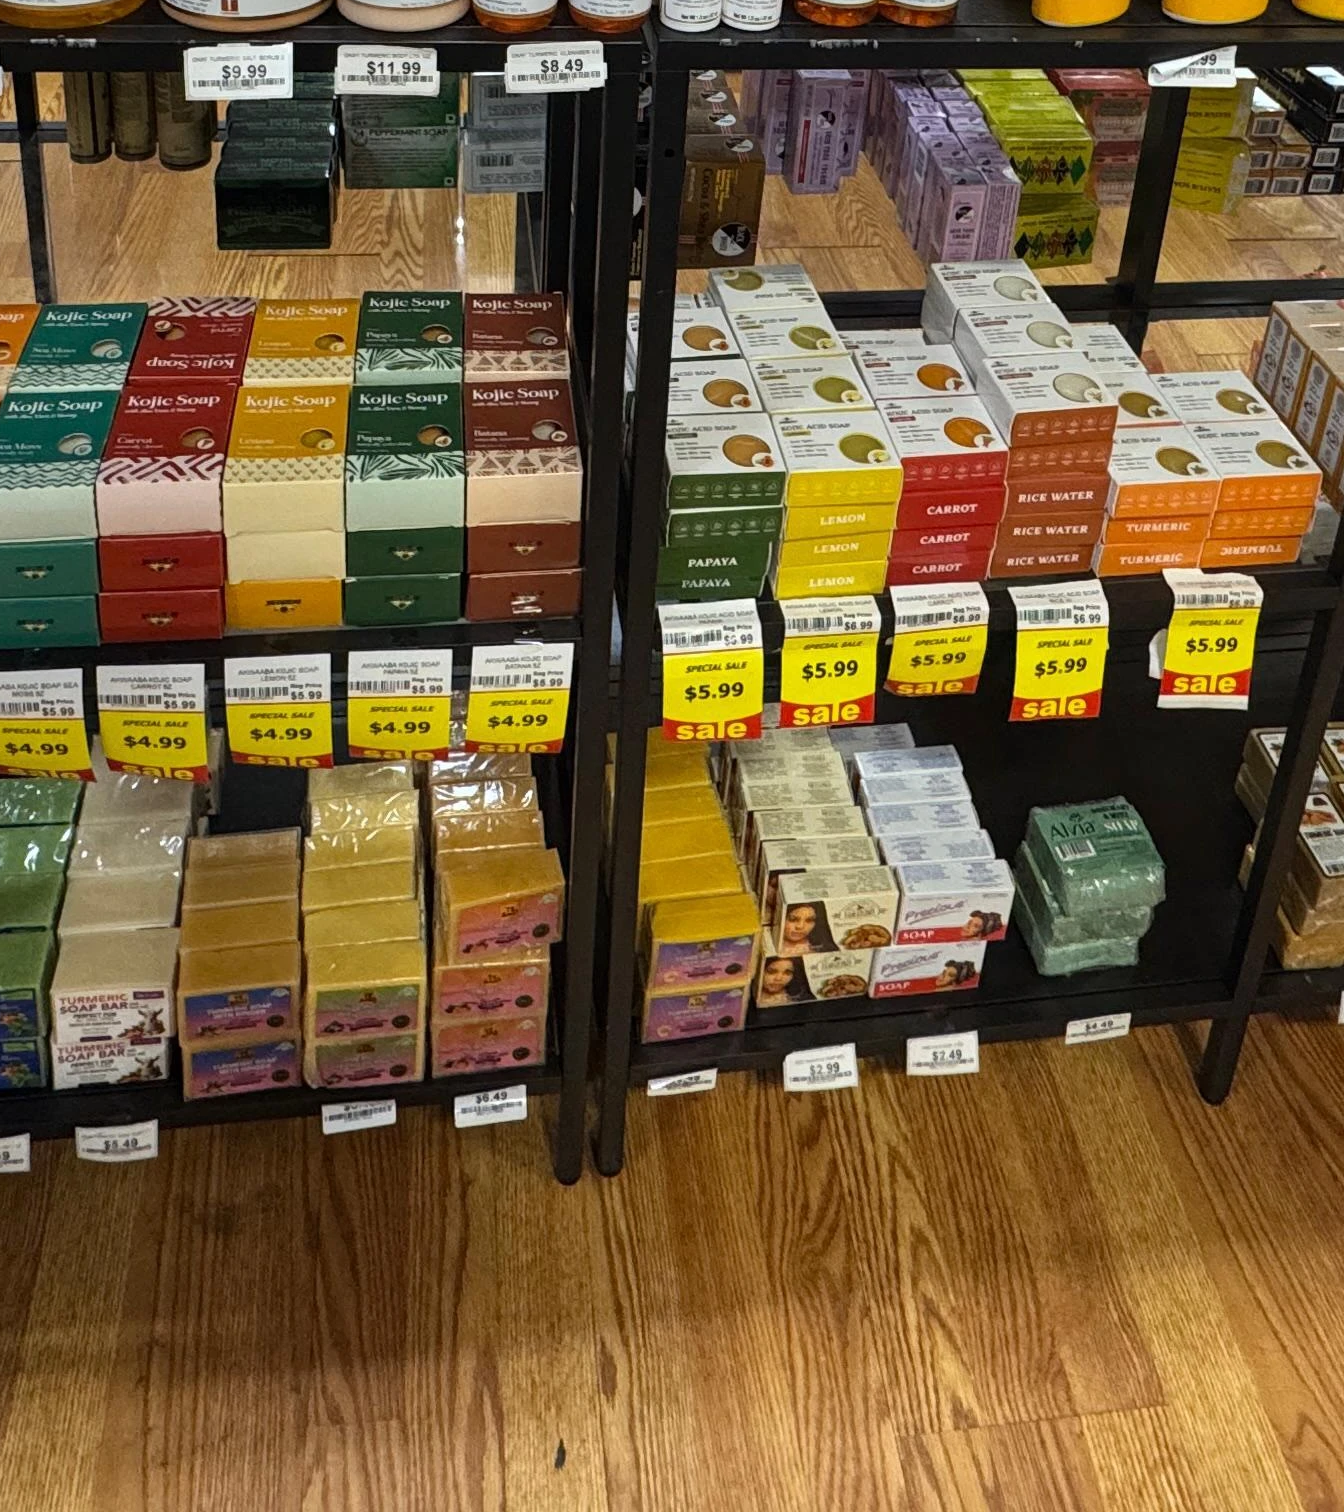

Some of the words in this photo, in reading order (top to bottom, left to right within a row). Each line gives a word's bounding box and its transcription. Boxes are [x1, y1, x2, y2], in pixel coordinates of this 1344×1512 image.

[222, 64, 267, 78] $9.99
[366, 61, 421, 76] $11.99
[540, 58, 584, 73] $8.49
[8, 400, 55, 414] Kojic
[58, 399, 104, 412] Soap
[1018, 493, 1047, 503] RICE
[1051, 491, 1094, 501] WATER
[926, 503, 978, 515] CARROT
[820, 513, 866, 526] LEMON
[1125, 522, 1191, 532] TURMERIC
[688, 557, 738, 568] PAPAYA
[1073, 613, 1101, 625] $6.99
[1037, 640, 1071, 649] SPECIAL
[1072, 638, 1093, 647] SALE
[802, 660, 859, 682] $5.99
[1034, 657, 1087, 679] $5.99
[684, 682, 744, 703] $5.99
[793, 702, 861, 726] sale
[676, 721, 747, 740] sale
[124, 736, 186, 750] $4.99
[1051, 821, 1096, 840] Alvia
[905, 901, 965, 922] Precious
[903, 929, 934, 939] SOAP
[932, 1049, 962, 1061] $2.49
[809, 1062, 840, 1074] $2.99
[476, 1092, 507, 1103] $6.49
